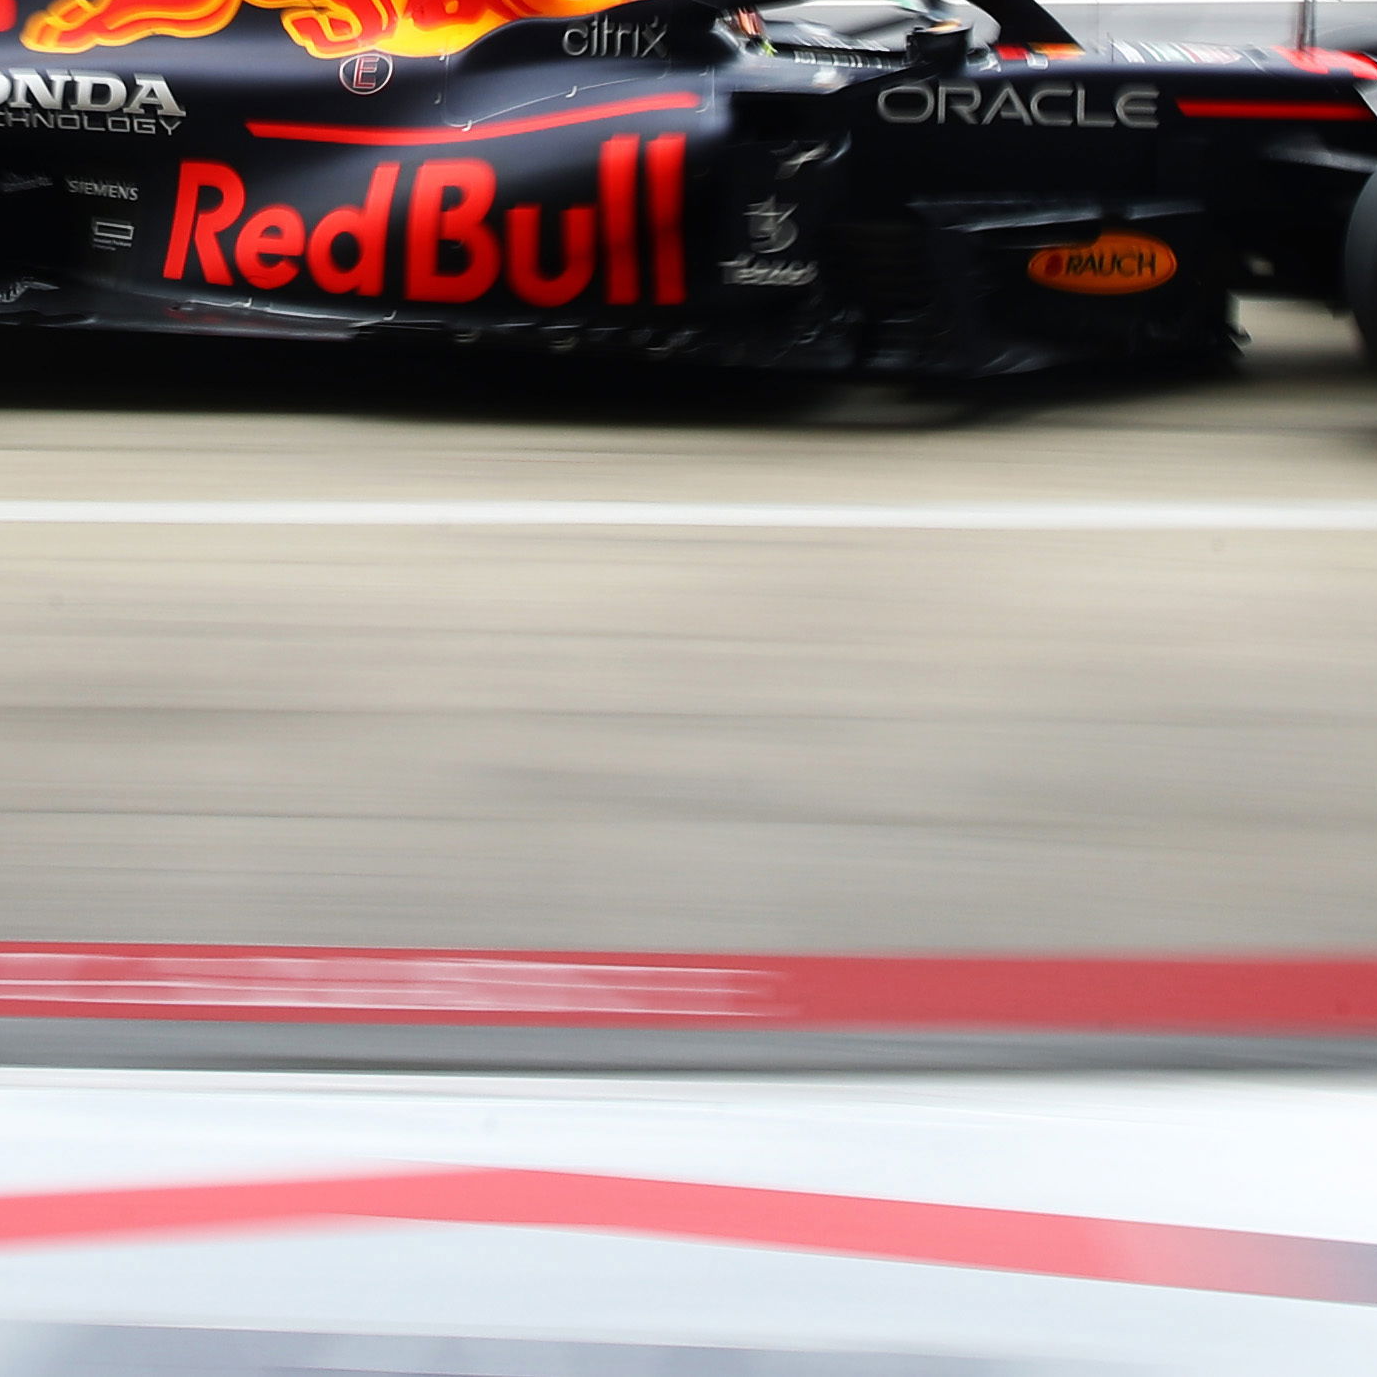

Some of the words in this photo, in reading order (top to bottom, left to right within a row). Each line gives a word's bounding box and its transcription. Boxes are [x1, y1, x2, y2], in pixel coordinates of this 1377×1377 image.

[563, 14, 669, 58] citrix
[876, 81, 1160, 128] ORACLE
[67, 179, 139, 201] SIEMENS
[163, 159, 400, 296] Red
[403, 133, 687, 306] Bull
[1064, 252, 1156, 277] RAUCH
